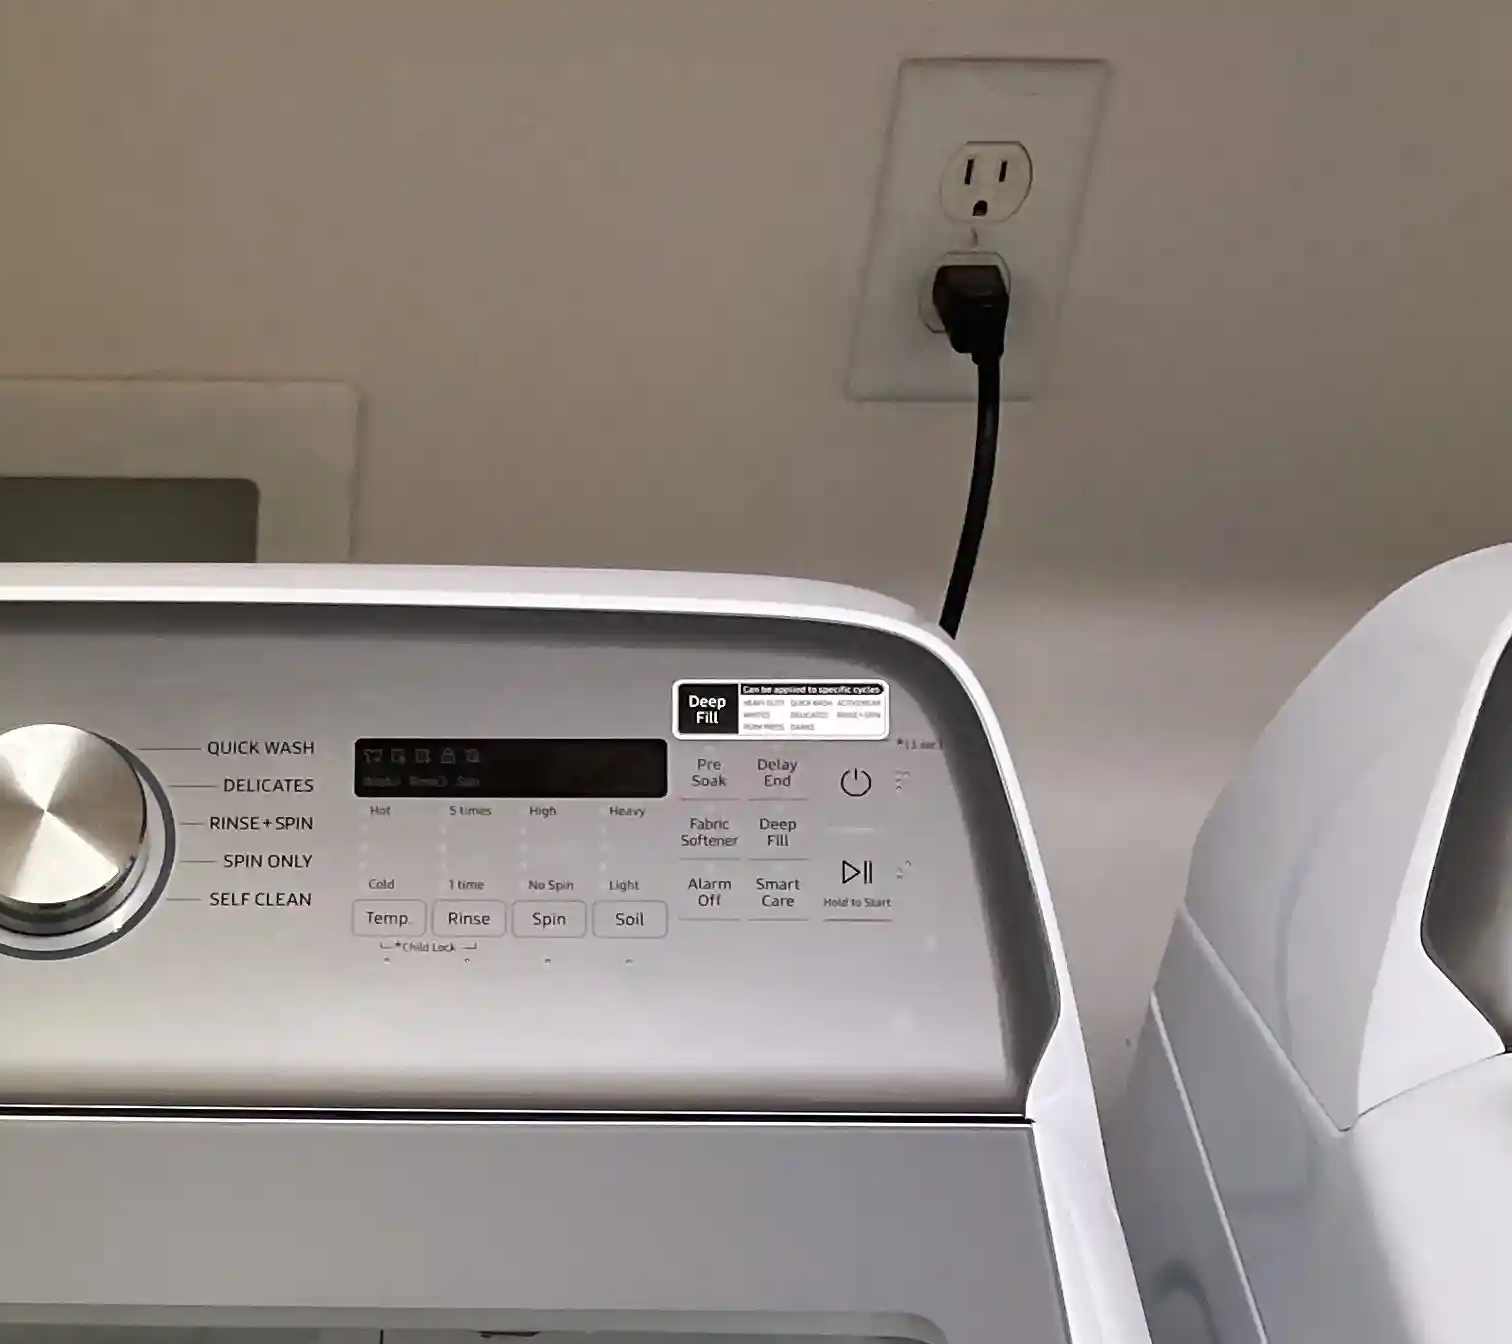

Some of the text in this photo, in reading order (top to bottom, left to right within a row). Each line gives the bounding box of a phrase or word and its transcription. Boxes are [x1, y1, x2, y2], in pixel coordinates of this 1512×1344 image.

[742, 685, 760, 694] Can
[852, 685, 882, 695] cycles
[688, 694, 727, 711] Deep
[696, 710, 719, 724] Fill
[207, 740, 315, 757] QUICK WASH
[697, 758, 722, 771] Pre
[757, 758, 798, 774] Delay
[223, 778, 314, 793] DELICATES
[692, 774, 727, 787] Soak
[764, 774, 792, 788] End
[369, 805, 391, 816] Hot
[459, 806, 493, 816] times
[529, 806, 557, 819] High
[609, 805, 646, 819] Heavy
[690, 817, 729, 831] Fabric
[759, 817, 797, 833] Deep
[680, 833, 739, 847] Softener
[767, 833, 789, 847] Fill
[223, 854, 313, 869] SPIN ONLY
[368, 878, 395, 890] Cold
[457, 879, 485, 891] time
[528, 879, 574, 893] No Spin
[609, 879, 640, 893] Light
[687, 877, 732, 890] Alarm
[756, 877, 801, 891] Smart
[209, 892, 312, 907] SELF CLEAN
[698, 893, 721, 907] Off
[761, 894, 795, 908] Care
[448, 911, 491, 926] Rinse
[532, 911, 566, 929] Spin
[615, 911, 645, 926] Soil
[432, 942, 456, 953] Lock
